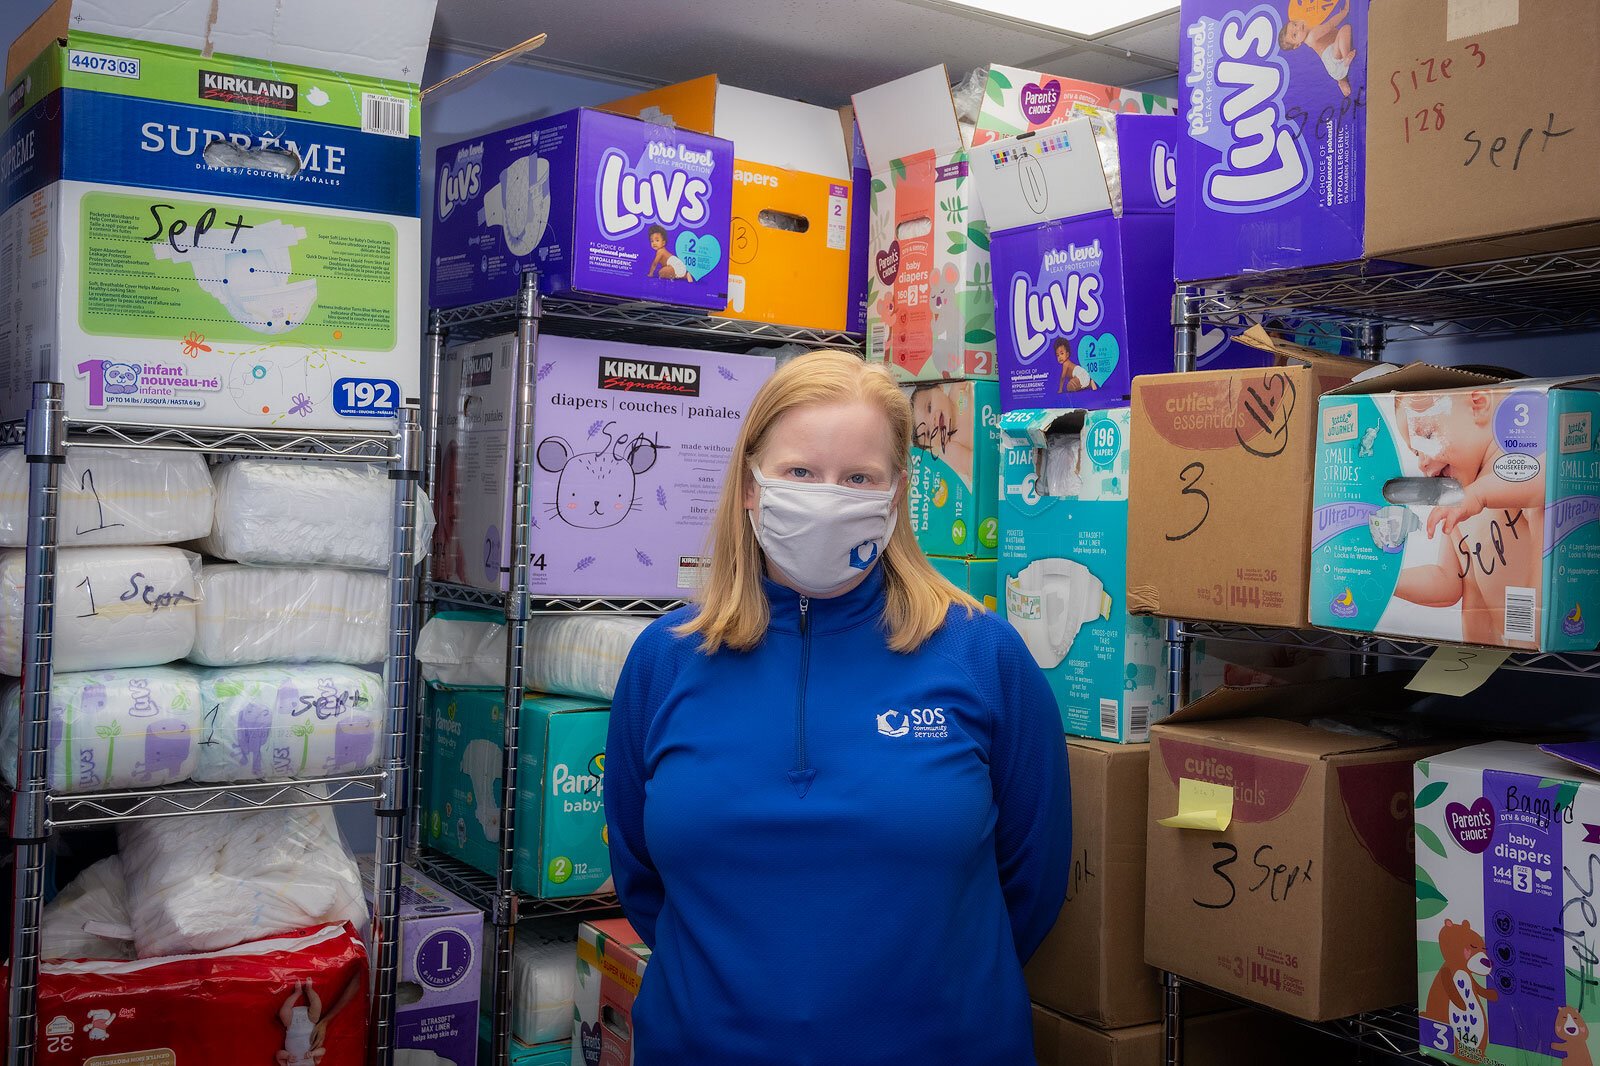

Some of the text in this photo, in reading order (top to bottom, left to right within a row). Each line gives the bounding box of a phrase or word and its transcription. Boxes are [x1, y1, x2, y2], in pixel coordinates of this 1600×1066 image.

[1206, 22, 1214, 93] PROTECTION
[1464, 43, 1486, 68] 3
[204, 74, 294, 100] KIRKLAND
[1188, 21, 1208, 136] pro level
[204, 88, 294, 108] Signature
[1025, 88, 1056, 104] Parent's
[1028, 104, 1051, 114] CHOICE
[1405, 102, 1446, 144] 128
[648, 141, 714, 168] pro level
[653, 157, 711, 174] LEAK PROTECTION
[734, 168, 778, 188] apers
[834, 205, 842, 216] 2
[144, 204, 254, 253] Sept
[688, 239, 696, 252] 2
[589, 256, 632, 266] HYPOALLERGENIC
[684, 256, 696, 267] 108
[878, 250, 898, 270] Parent's
[1045, 239, 1102, 272] pro level
[883, 264, 896, 278] CHOICE
[906, 261, 920, 270] baby
[1050, 261, 1100, 274] LEAK PROTECTION
[898, 271, 928, 284] diapers
[898, 290, 908, 299] 160
[1089, 342, 1096, 358] 2
[144, 364, 182, 376] infant
[604, 360, 696, 384] KIRKLAND
[972, 352, 988, 374] 2
[1087, 362, 1098, 373] 108
[77, 360, 104, 406] 1
[140, 387, 172, 396] infante
[141, 376, 218, 388] nouveau-né
[604, 376, 696, 392] Signature
[342, 382, 392, 408] 192
[1166, 394, 1214, 414] cuties
[551, 394, 741, 420] diapers couches pañales
[1514, 404, 1530, 426] 3
[1174, 412, 1246, 431] essentials
[1332, 414, 1348, 426] little
[1094, 428, 1114, 447] 196
[1328, 424, 1354, 436] JOURNEY
[1504, 440, 1518, 448] 100
[1564, 434, 1588, 448] JOURNEY
[1325, 448, 1354, 464] SMALL
[1560, 460, 1588, 477] SMALL
[910, 455, 922, 541] ampers
[922, 466, 931, 530] baby-dry
[1028, 480, 1036, 498] 2
[76, 468, 124, 536] 1
[1166, 462, 1210, 541] 3
[1319, 506, 1368, 530] UltraDry
[1555, 501, 1598, 528] UltraDry
[954, 526, 962, 538] 2
[986, 520, 996, 540] 2
[1236, 568, 1278, 582] 4 36
[1334, 566, 1372, 575] Hypoallergenic
[76, 576, 98, 618] 1
[1213, 584, 1222, 606] 3
[1230, 586, 1260, 608] 144
[1444, 652, 1478, 673] 3
[198, 704, 220, 745] 1
[436, 708, 461, 736] Pampers
[910, 708, 946, 725] SOS
[1184, 757, 1234, 781] cuties
[1506, 786, 1575, 829] Bagged
[1452, 808, 1491, 828] Parent's
[1460, 828, 1488, 841] CHOICE
[1508, 833, 1536, 848] baby
[1494, 844, 1551, 866] diapers
[556, 860, 565, 876] 2
[574, 863, 588, 874] 112
[1192, 842, 1238, 909] 3
[1248, 844, 1312, 901] Sept
[1492, 866, 1512, 879] 144
[1517, 872, 1528, 890] 3
[437, 940, 452, 972] 1
[1258, 946, 1298, 968] 4 36
[604, 962, 635, 986] SUPER VALUE
[1234, 956, 1281, 992] 3 144
[47, 1036, 74, 1053] 32
[413, 1034, 426, 1042] helps
[427, 1032, 438, 1042] keep
[583, 1031, 600, 1049] Parent's
[1433, 1023, 1448, 1050] 3
[1458, 1030, 1478, 1046] 144
